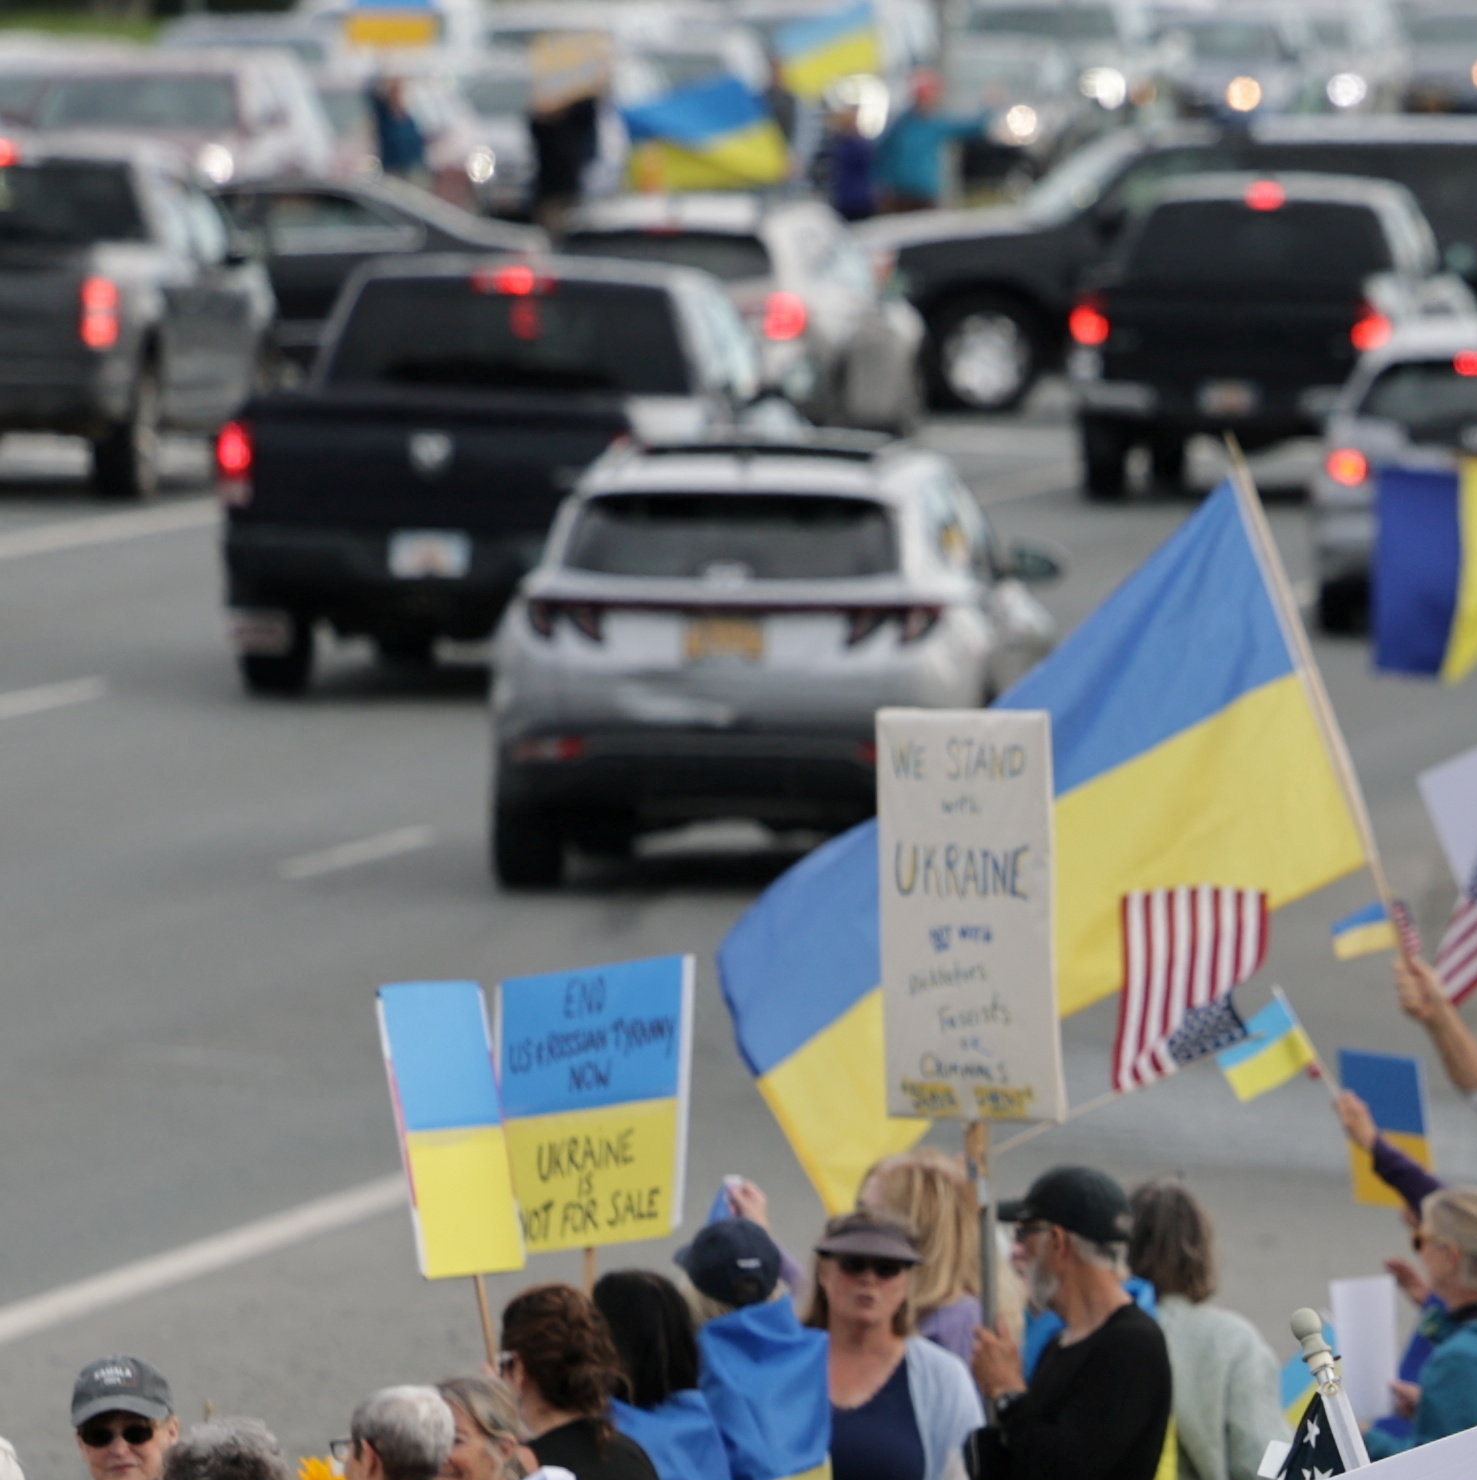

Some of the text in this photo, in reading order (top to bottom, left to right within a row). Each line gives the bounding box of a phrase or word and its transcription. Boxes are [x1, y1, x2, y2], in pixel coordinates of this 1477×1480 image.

[891, 737, 1026, 781] WE STAND
[894, 842, 1030, 899] UKRAINE
[563, 977, 607, 1020] END
[509, 1037, 532, 1074] US
[569, 1058, 613, 1090] NOW
[537, 1128, 634, 1183] UKRAINE
[577, 1172, 593, 1197] IS
[561, 1198, 599, 1238] FOR
[607, 1187, 661, 1227] SALE
